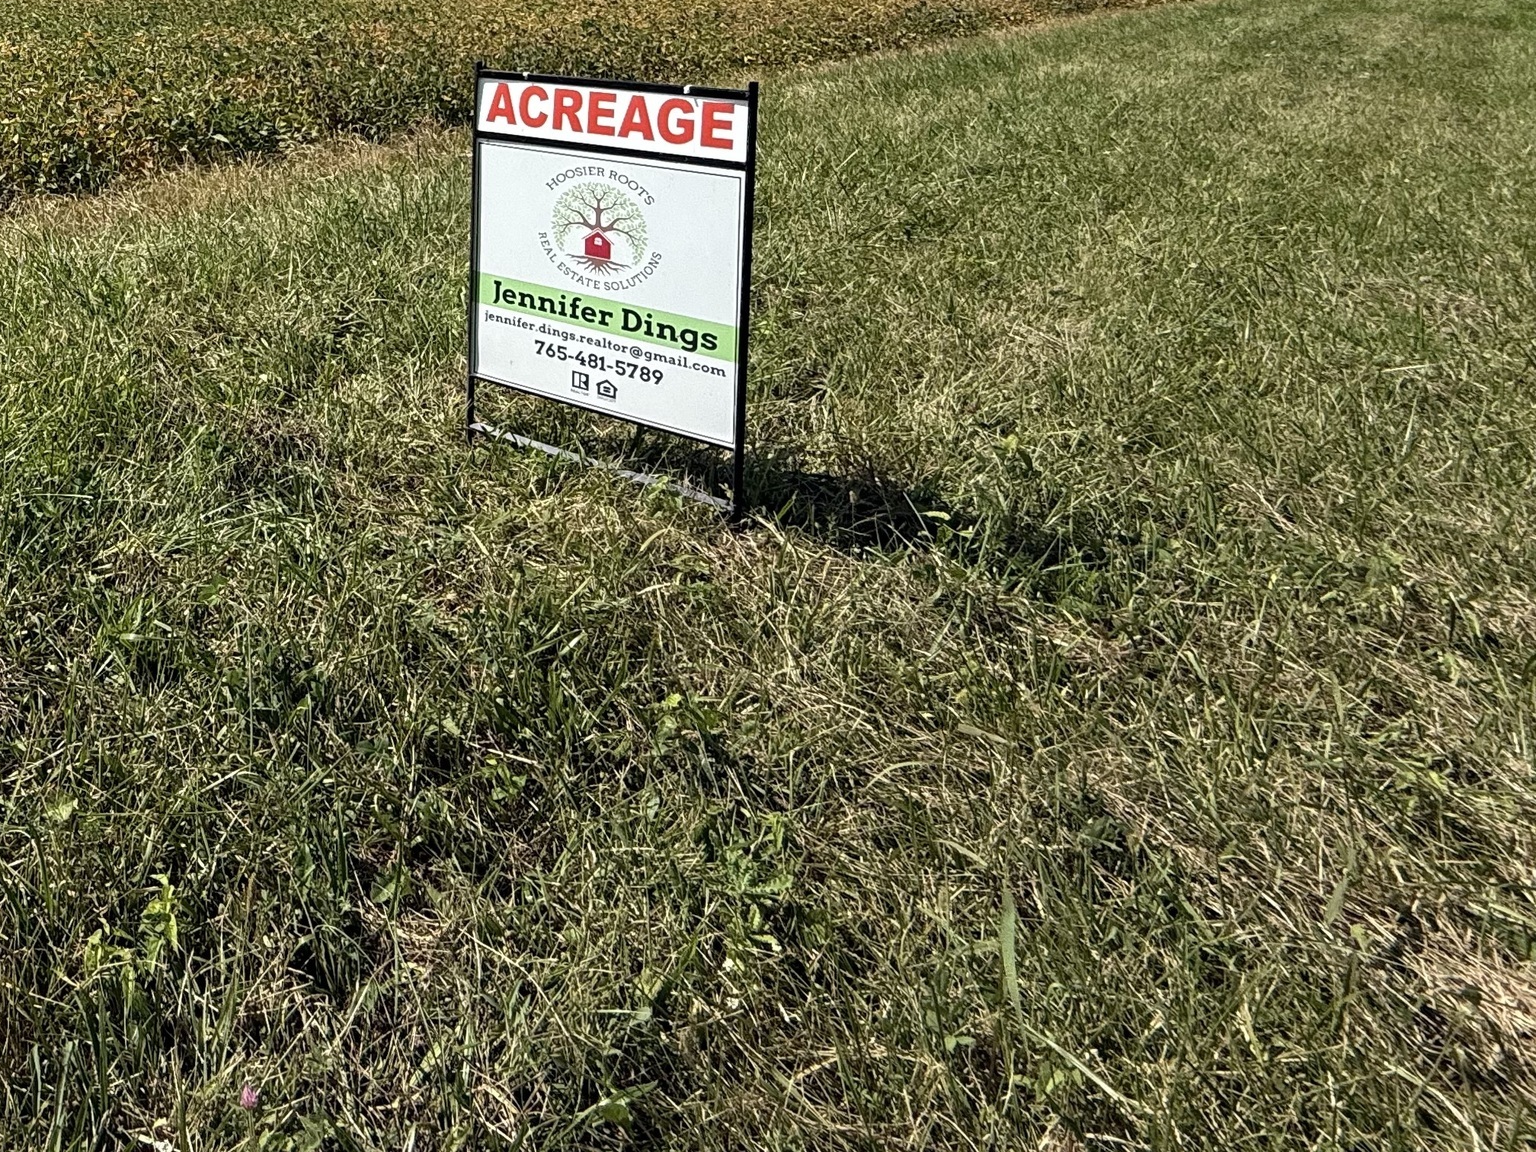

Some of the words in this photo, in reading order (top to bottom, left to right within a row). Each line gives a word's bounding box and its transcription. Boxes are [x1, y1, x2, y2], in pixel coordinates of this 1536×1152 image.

[486, 82, 735, 150] ACREAGE
[545, 166, 605, 191] HOOSIER
[608, 170, 655, 206] ROOTS
[538, 231, 556, 263] REAL
[557, 262, 600, 290] ESTATE
[604, 251, 662, 291] SOLUTIONS
[484, 310, 727, 378] jennifer.dings.realtor@gmail.com
[493, 280, 613, 327] Jennifer
[621, 308, 718, 352] Dings
[534, 340, 664, 385] 765-481-5789
